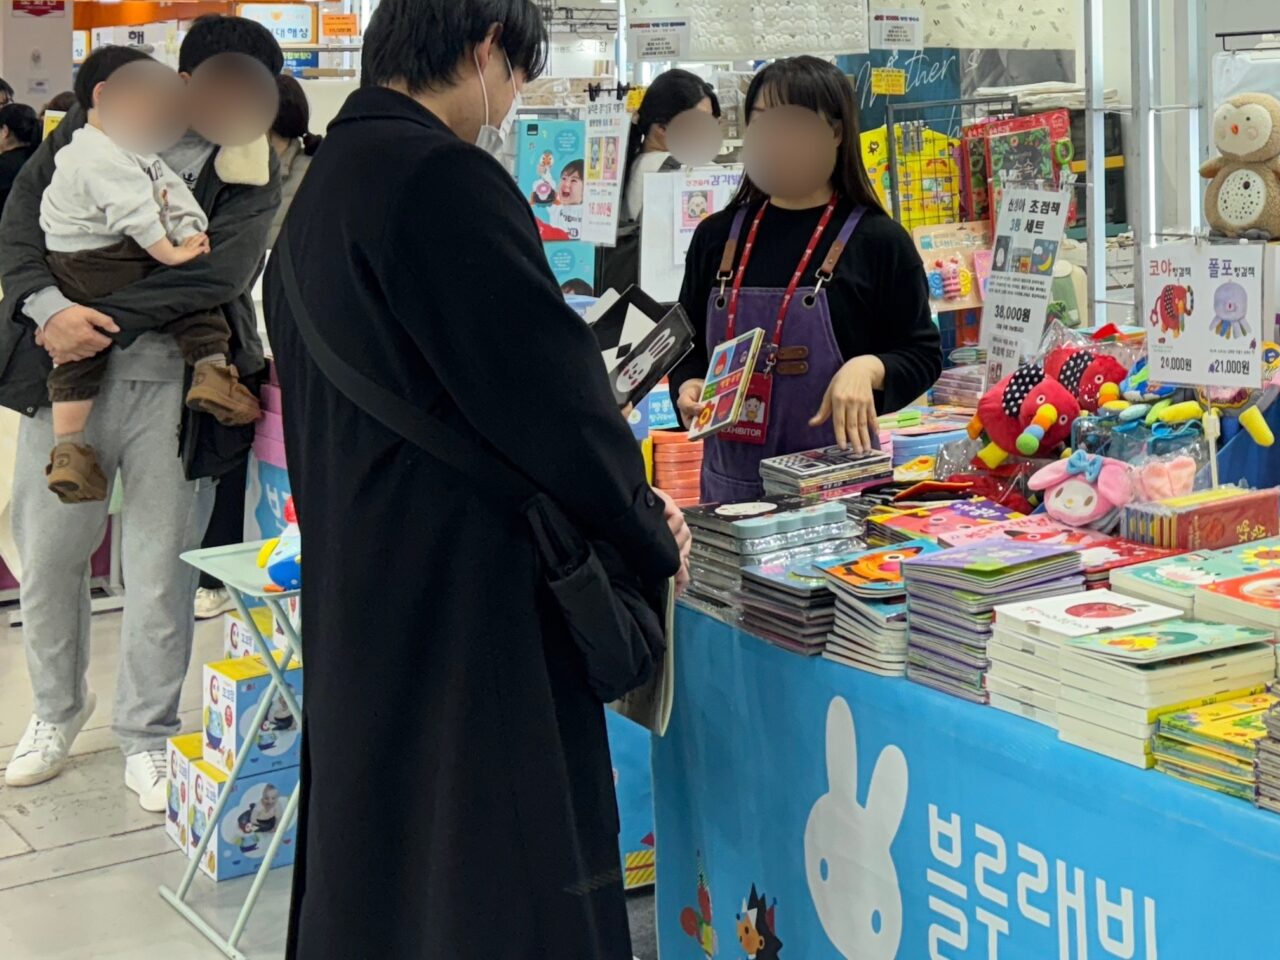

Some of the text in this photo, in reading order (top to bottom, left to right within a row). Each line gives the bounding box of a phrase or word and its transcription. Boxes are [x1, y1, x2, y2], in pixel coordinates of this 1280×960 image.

[1028, 199, 1062, 216] 초점책
[1024, 218, 1045, 234] 세트
[1208, 257, 1233, 278] 폴포
[1215, 360, 1250, 375] 21,000원
